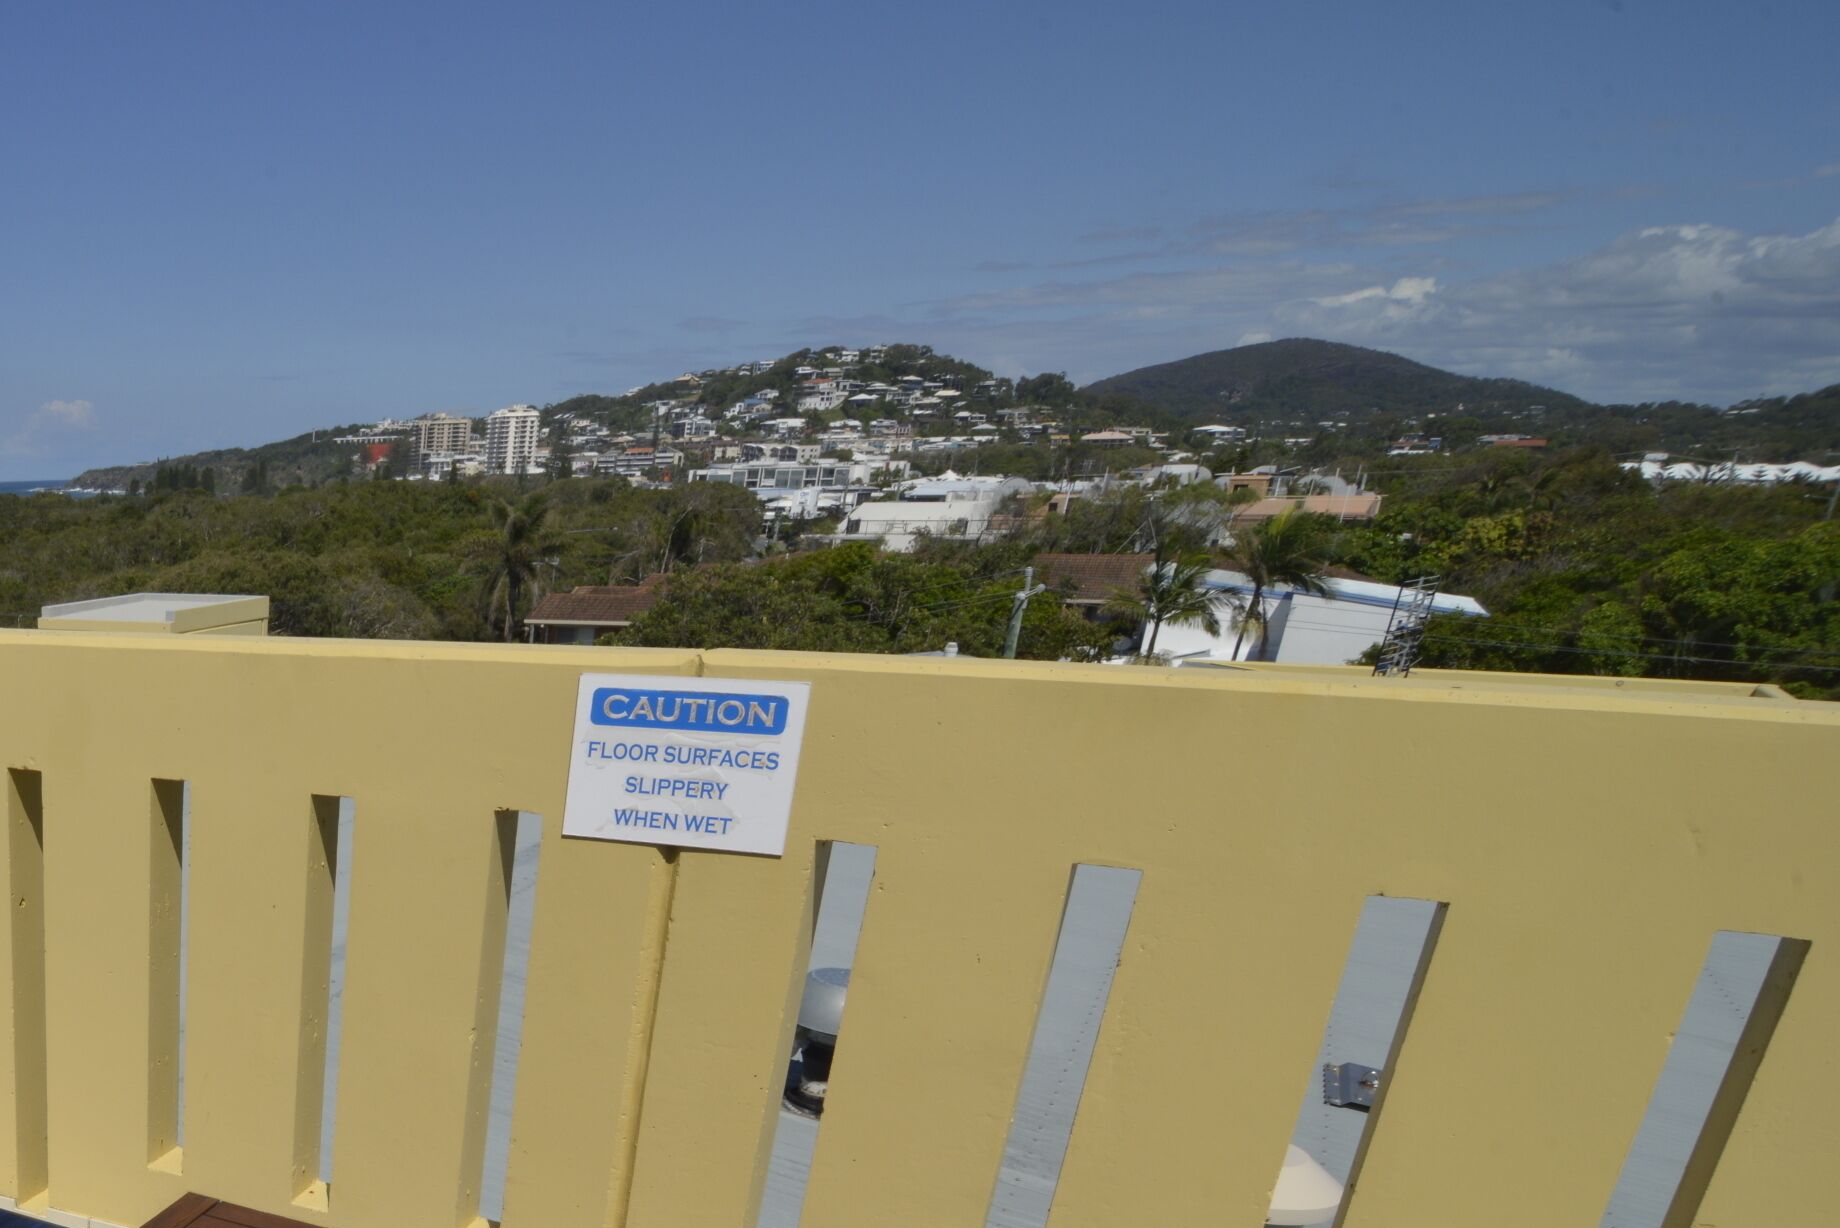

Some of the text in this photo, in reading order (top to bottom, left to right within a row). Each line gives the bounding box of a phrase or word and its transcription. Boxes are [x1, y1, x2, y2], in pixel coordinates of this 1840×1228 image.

[603, 694, 777, 727] CAUTION
[587, 741, 780, 770] FLOOR SURFACES
[624, 776, 729, 800] SLIPPERY
[614, 808, 733, 834] WHEN WET
